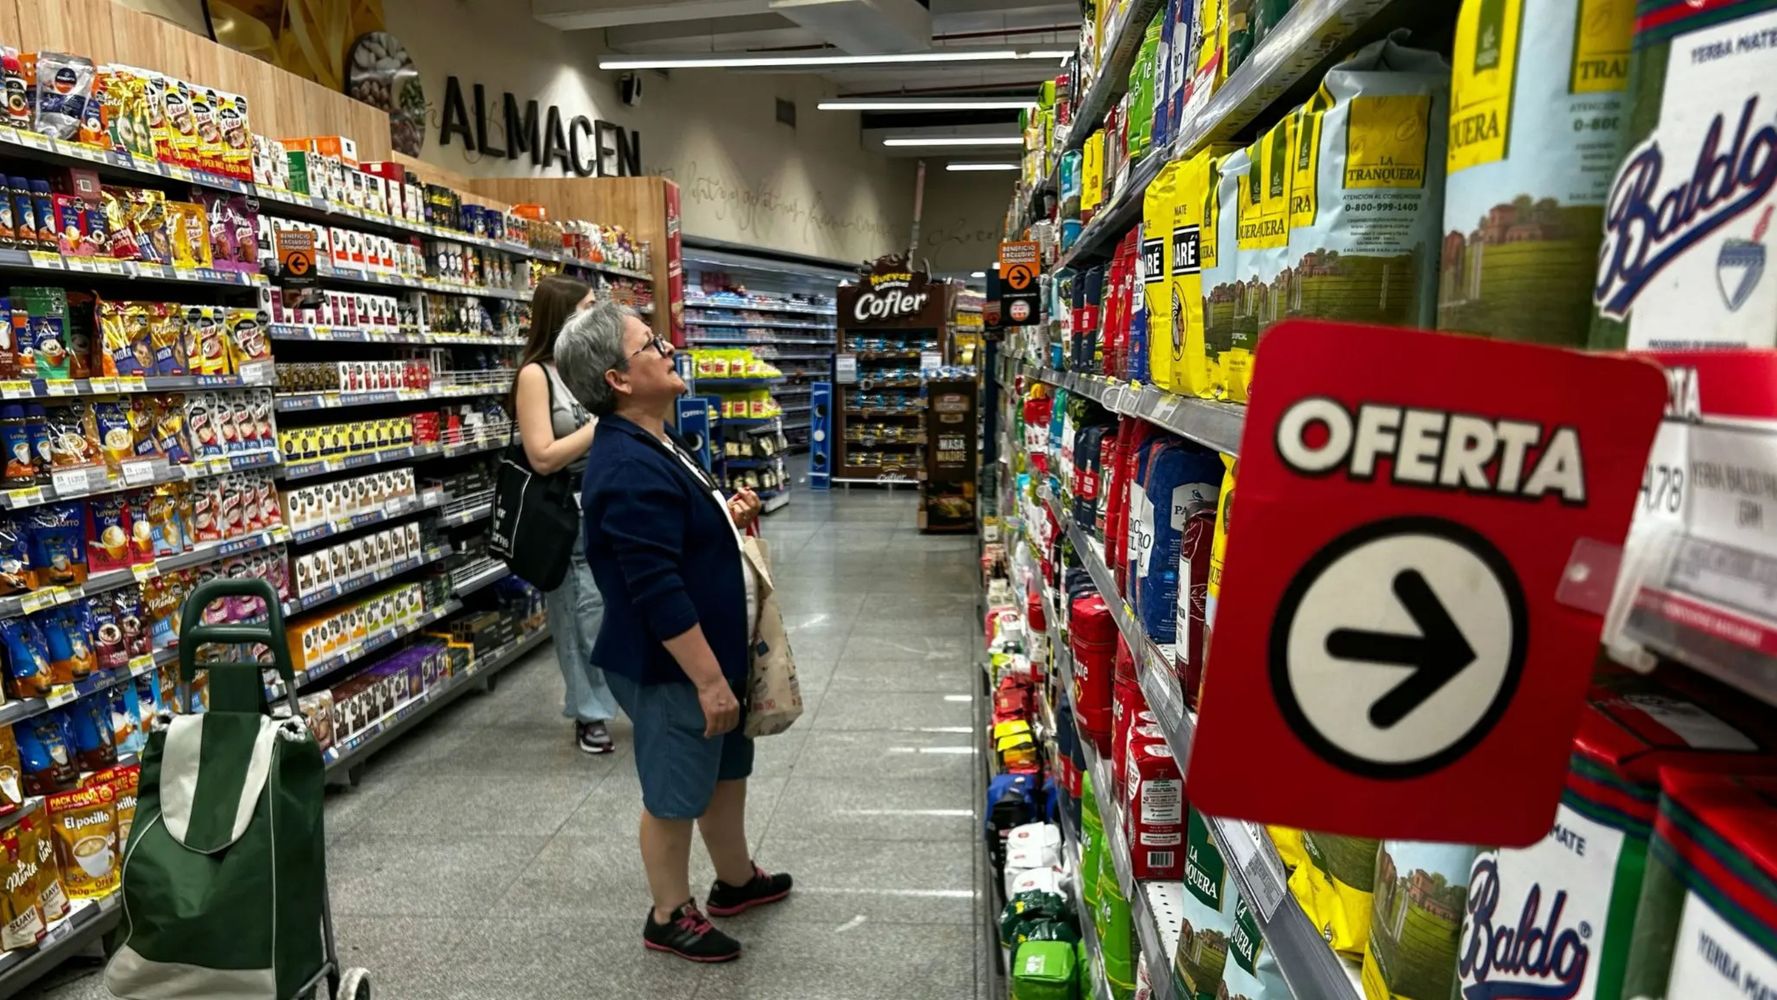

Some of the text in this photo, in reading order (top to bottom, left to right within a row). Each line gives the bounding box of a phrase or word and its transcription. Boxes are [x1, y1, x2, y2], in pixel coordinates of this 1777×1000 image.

[1690, 40, 1733, 64] YERBA
[438, 76, 642, 177] ALMACEN
[1380, 156, 1393, 166] LA
[1348, 167, 1421, 184] TRANQUERA
[1345, 203, 1419, 212] 0-800-999-1405
[854, 290, 927, 321] Cofler
[939, 439, 965, 450] MASA
[1275, 396, 1587, 505] OFERTA
[64, 810, 110, 830] El pocillo
[1190, 845, 1198, 863] LA
[9, 908, 36, 931] SUAVE
[1458, 859, 1589, 982] Baldo
[1698, 928, 1740, 987] YERBA
